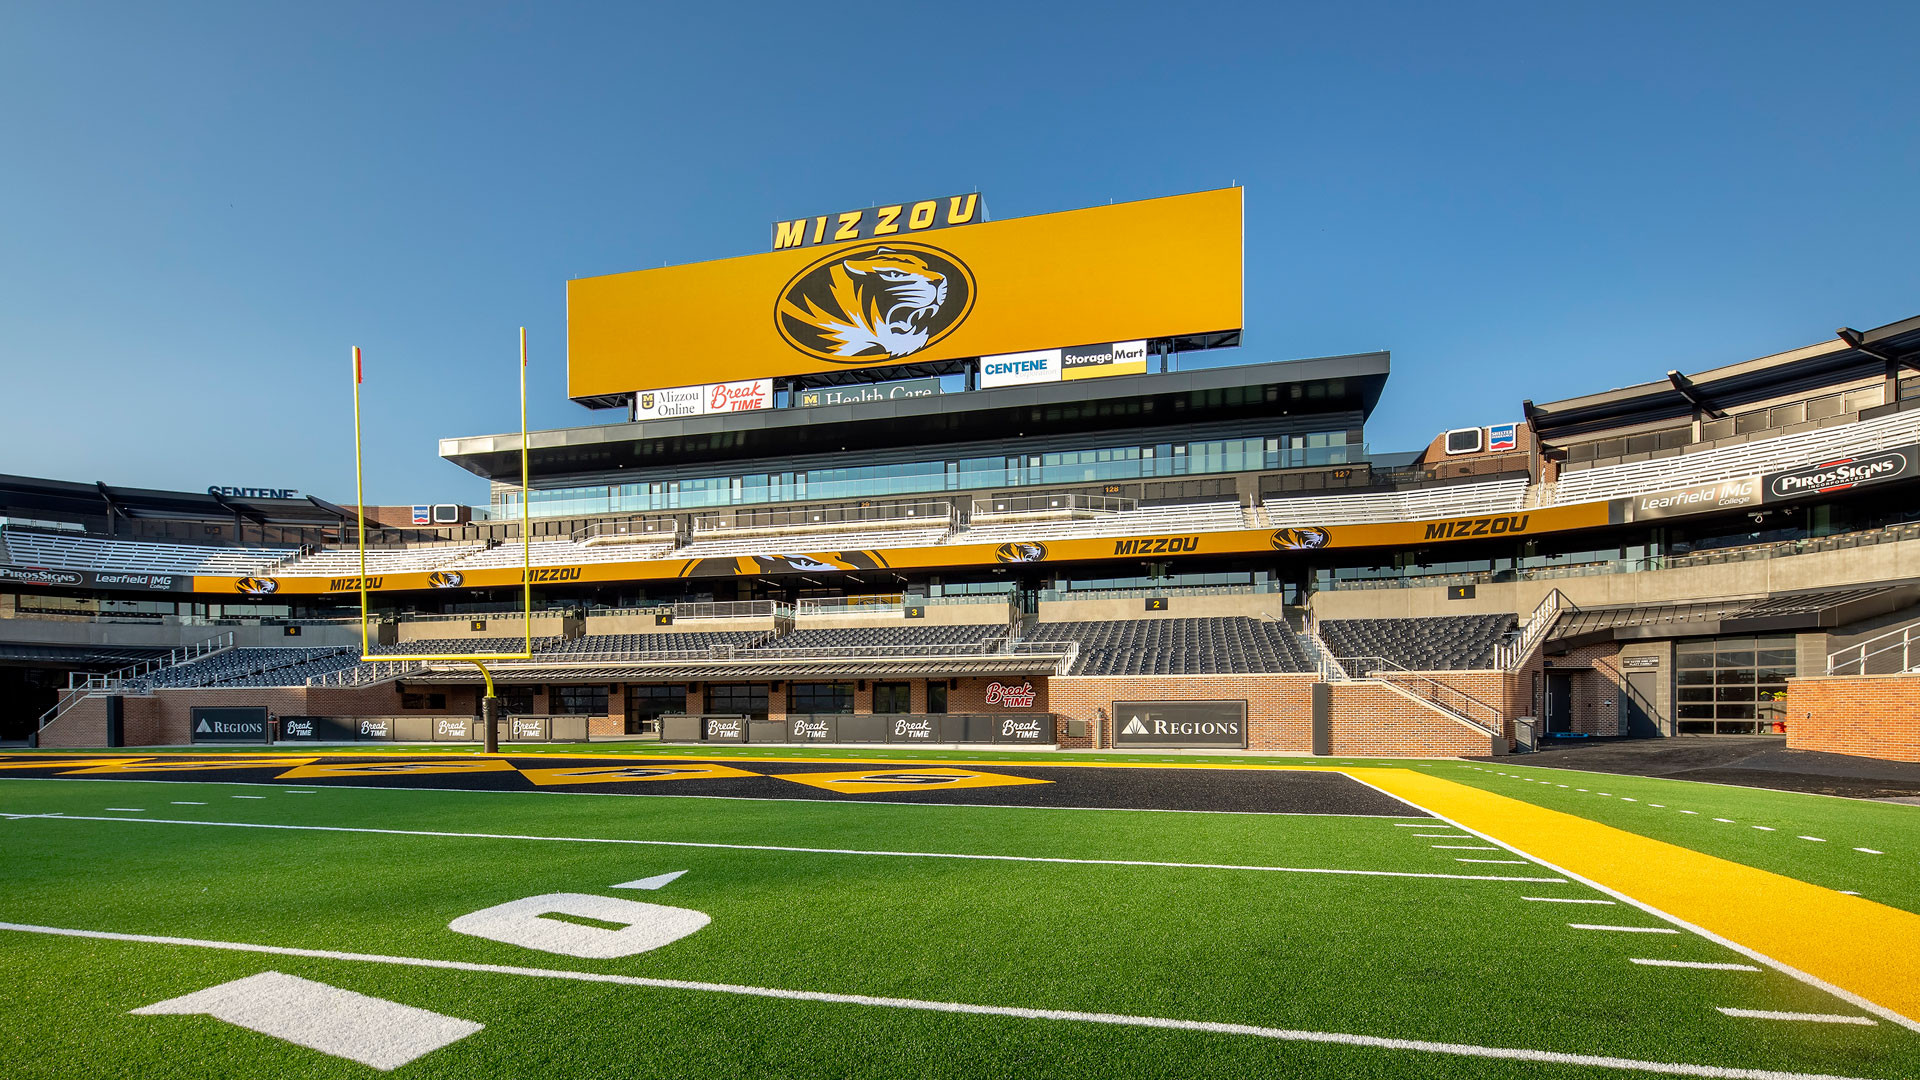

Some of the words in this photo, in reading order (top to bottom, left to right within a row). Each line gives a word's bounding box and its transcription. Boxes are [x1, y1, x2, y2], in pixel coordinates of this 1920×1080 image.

[774, 194, 978, 249] MIZZOU
[1065, 353, 1112, 365] Storage
[1114, 348, 1144, 360] Mart
[985, 359, 1048, 375] CENTENE
[659, 390, 700, 404] Mizzou
[711, 381, 766, 409] Break
[825, 388, 884, 405] Health
[658, 405, 696, 416] Online
[730, 398, 763, 411] TIME
[1641, 488, 1715, 511] Learfield
[1721, 482, 1753, 498] IMG
[1718, 496, 1751, 506] College
[1424, 515, 1529, 540] MIZZOU
[1113, 537, 1199, 555] MIZZOU
[95, 573, 148, 585] Learfield
[151, 576, 172, 585] IMG
[521, 568, 581, 582] MIZZOU
[330, 577, 383, 591] MIZZOU
[1153, 600, 1160, 609] 2
[911, 608, 918, 617] 3
[985, 681, 1036, 705] Break
[1003, 696, 1033, 708] TIME
[214, 721, 263, 733] REGIONS
[287, 720, 313, 734] Break
[361, 720, 388, 734] Break
[438, 720, 466, 734] Break
[513, 720, 541, 734] Break
[707, 719, 741, 736] Break
[719, 730, 739, 738] TIME
[794, 719, 827, 735] Break
[806, 730, 827, 738] TIME
[894, 719, 931, 735] Break
[907, 730, 931, 738] TIME
[1002, 719, 1041, 736] Break
[1016, 730, 1040, 738] TIME
[1154, 719, 1238, 735] REGIONS
